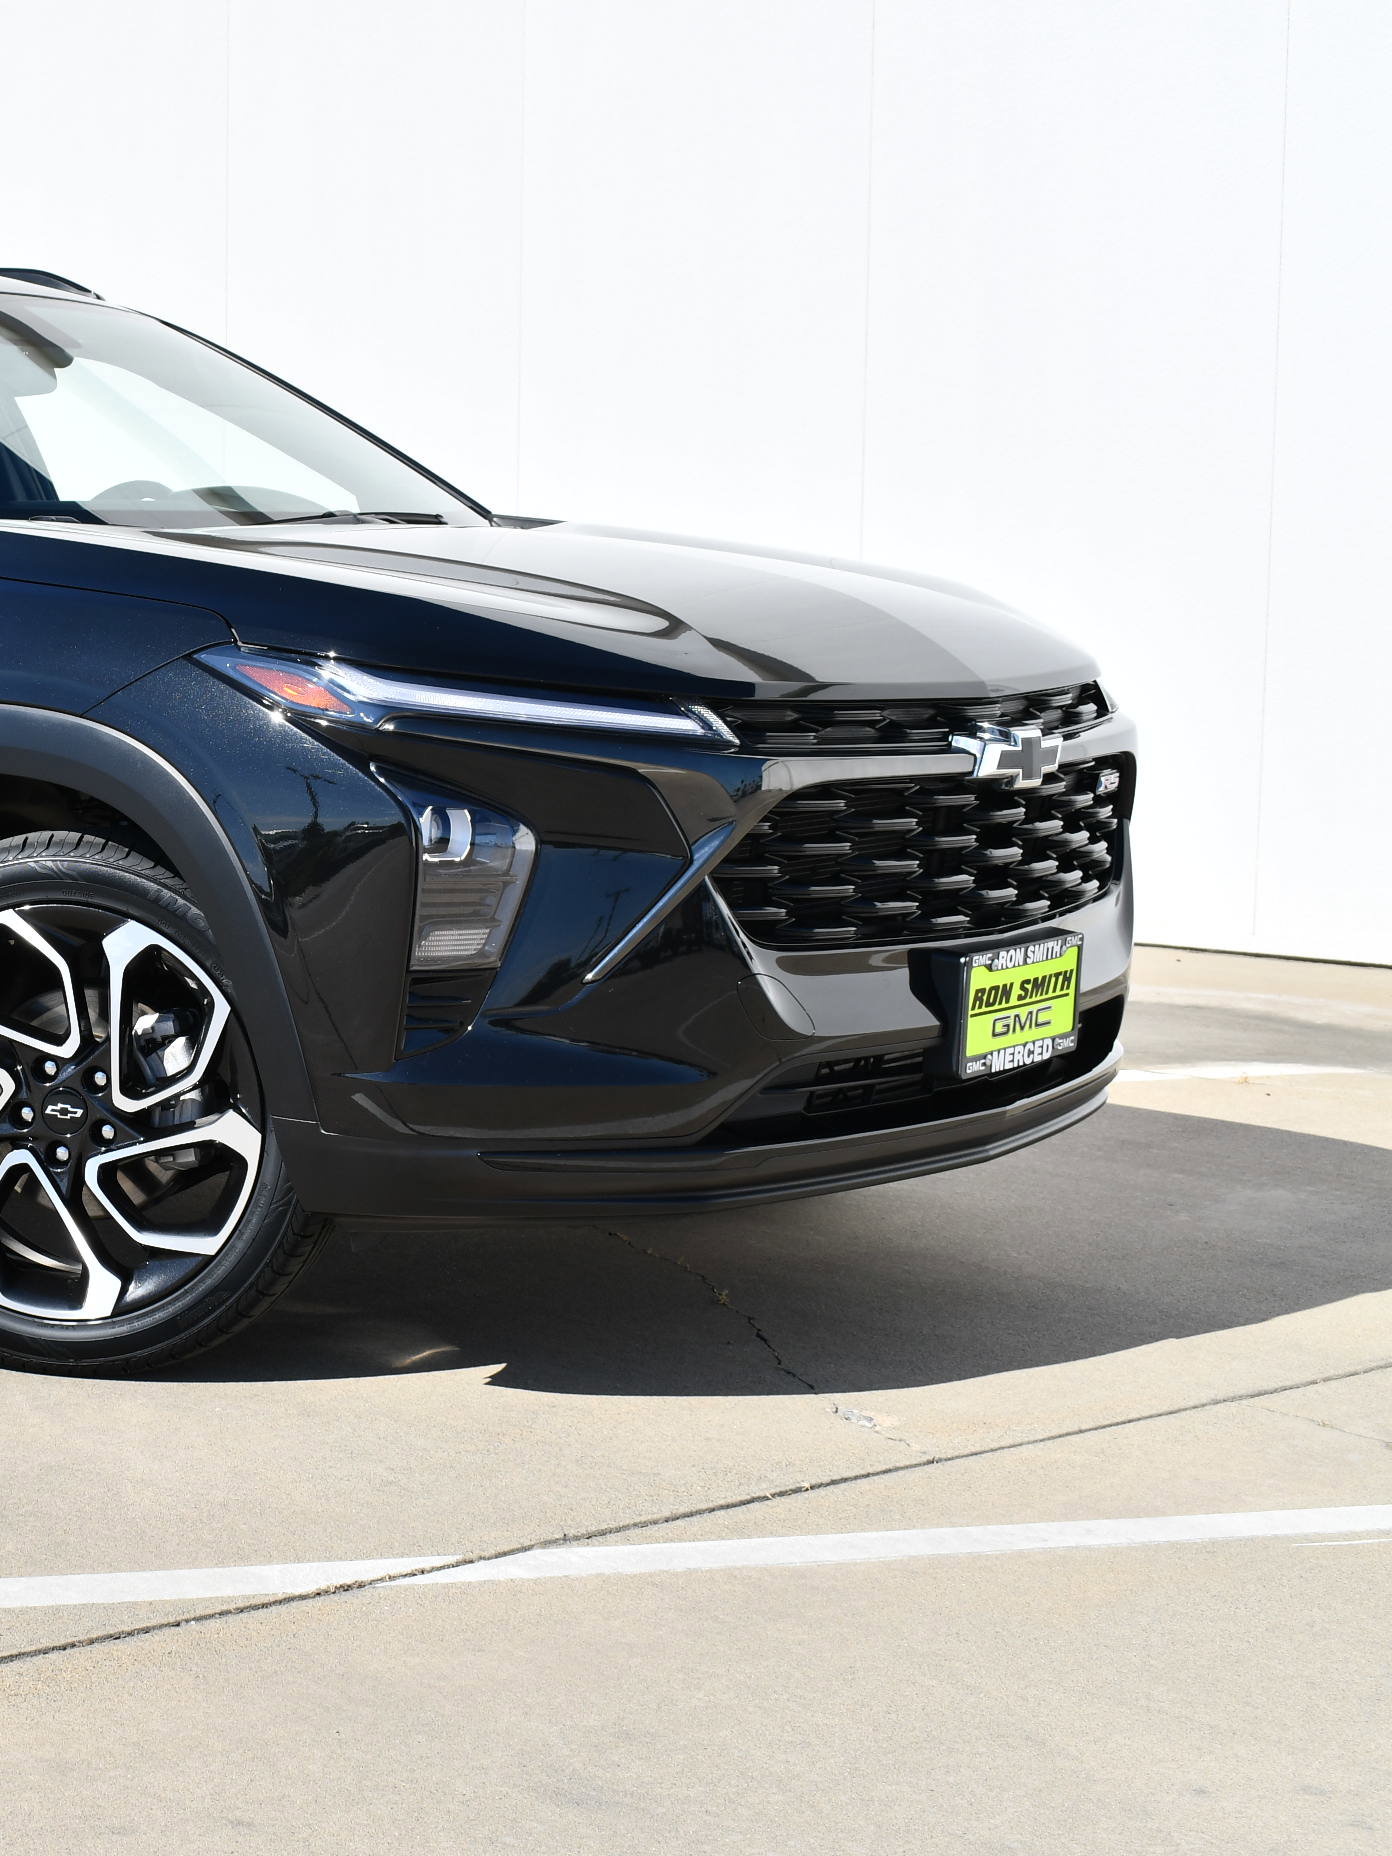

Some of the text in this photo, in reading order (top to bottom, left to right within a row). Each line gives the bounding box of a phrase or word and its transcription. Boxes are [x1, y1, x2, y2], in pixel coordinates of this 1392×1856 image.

[972, 934, 1083, 970] GMC RON SMITH GMC
[971, 968, 1074, 1012] RON SMITH
[992, 1005, 1052, 1038] GMC
[966, 1036, 1075, 1074] GMC MERCED GMC
